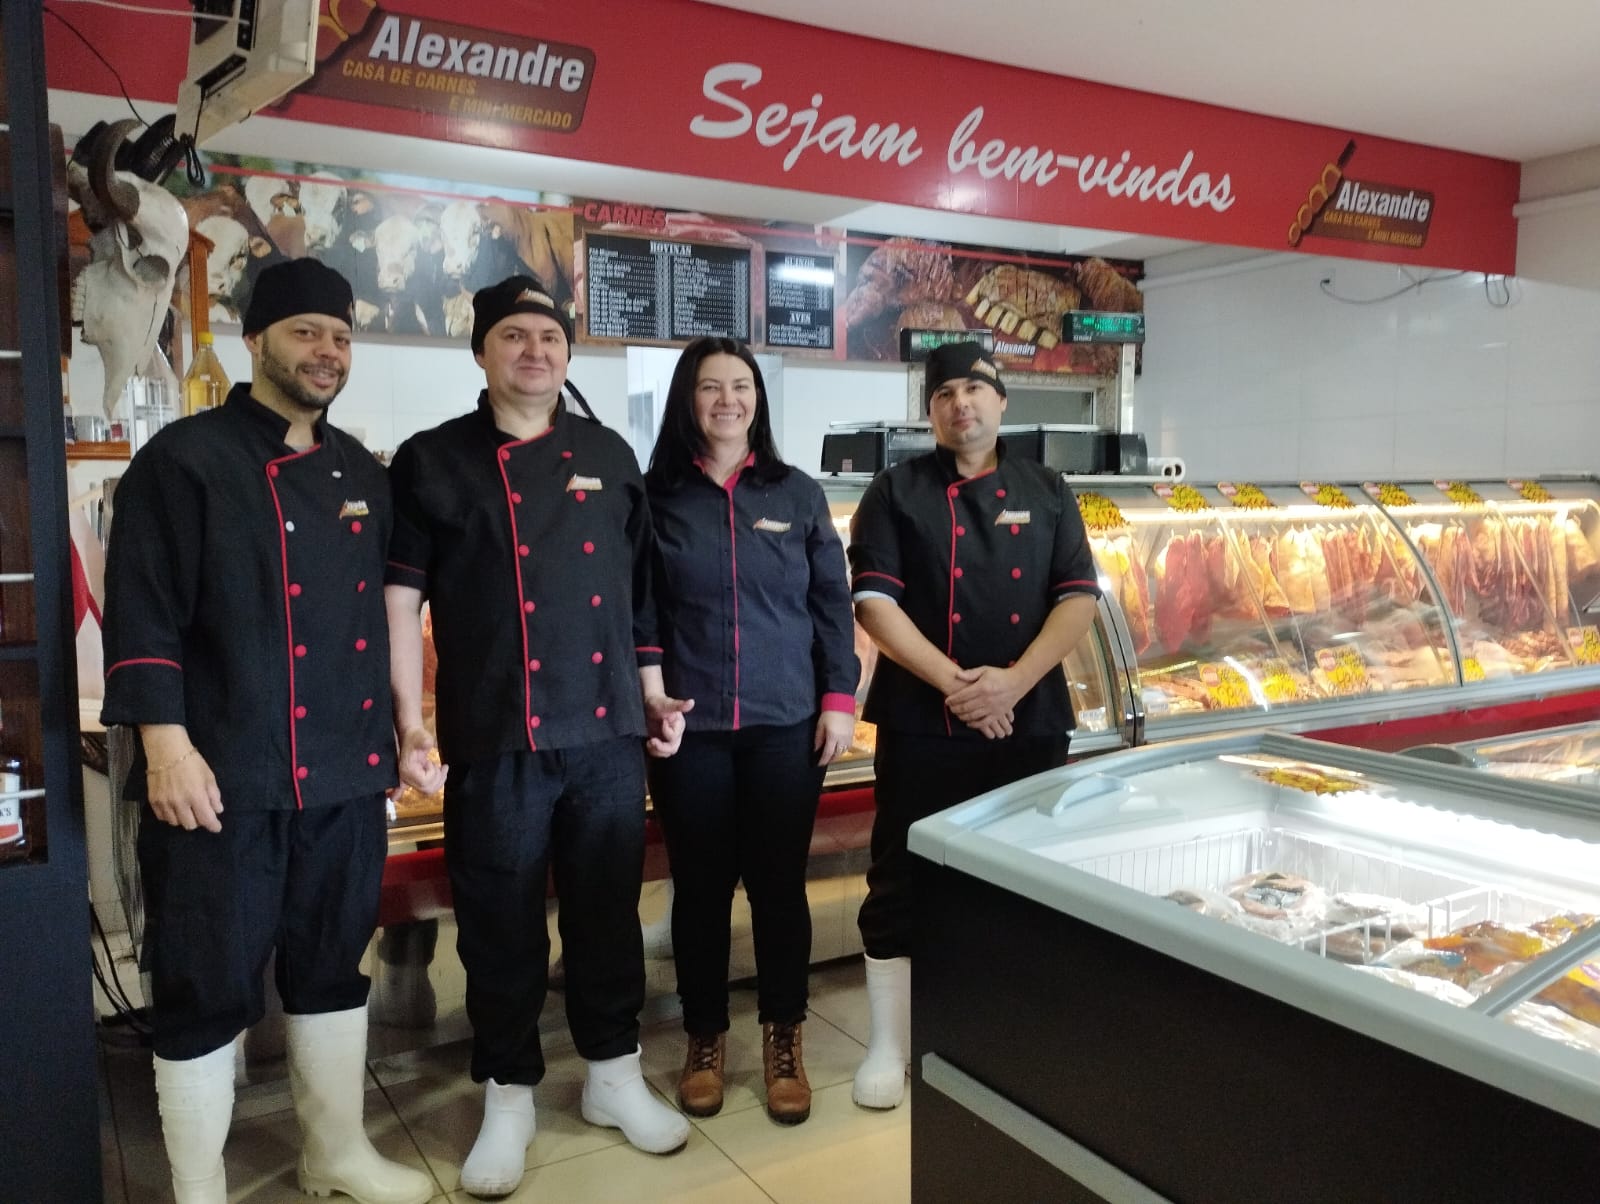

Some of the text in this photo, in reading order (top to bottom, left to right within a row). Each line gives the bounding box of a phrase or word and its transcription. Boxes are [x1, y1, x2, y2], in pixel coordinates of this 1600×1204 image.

[368, 15, 585, 92] Alexandre
[342, 59, 477, 95] CASA DE CARNES
[448, 96, 461, 111] E
[690, 62, 1236, 213] Sejam bem-vindos
[584, 203, 666, 229] CARNES
[1335, 180, 1430, 223] Alexandre
